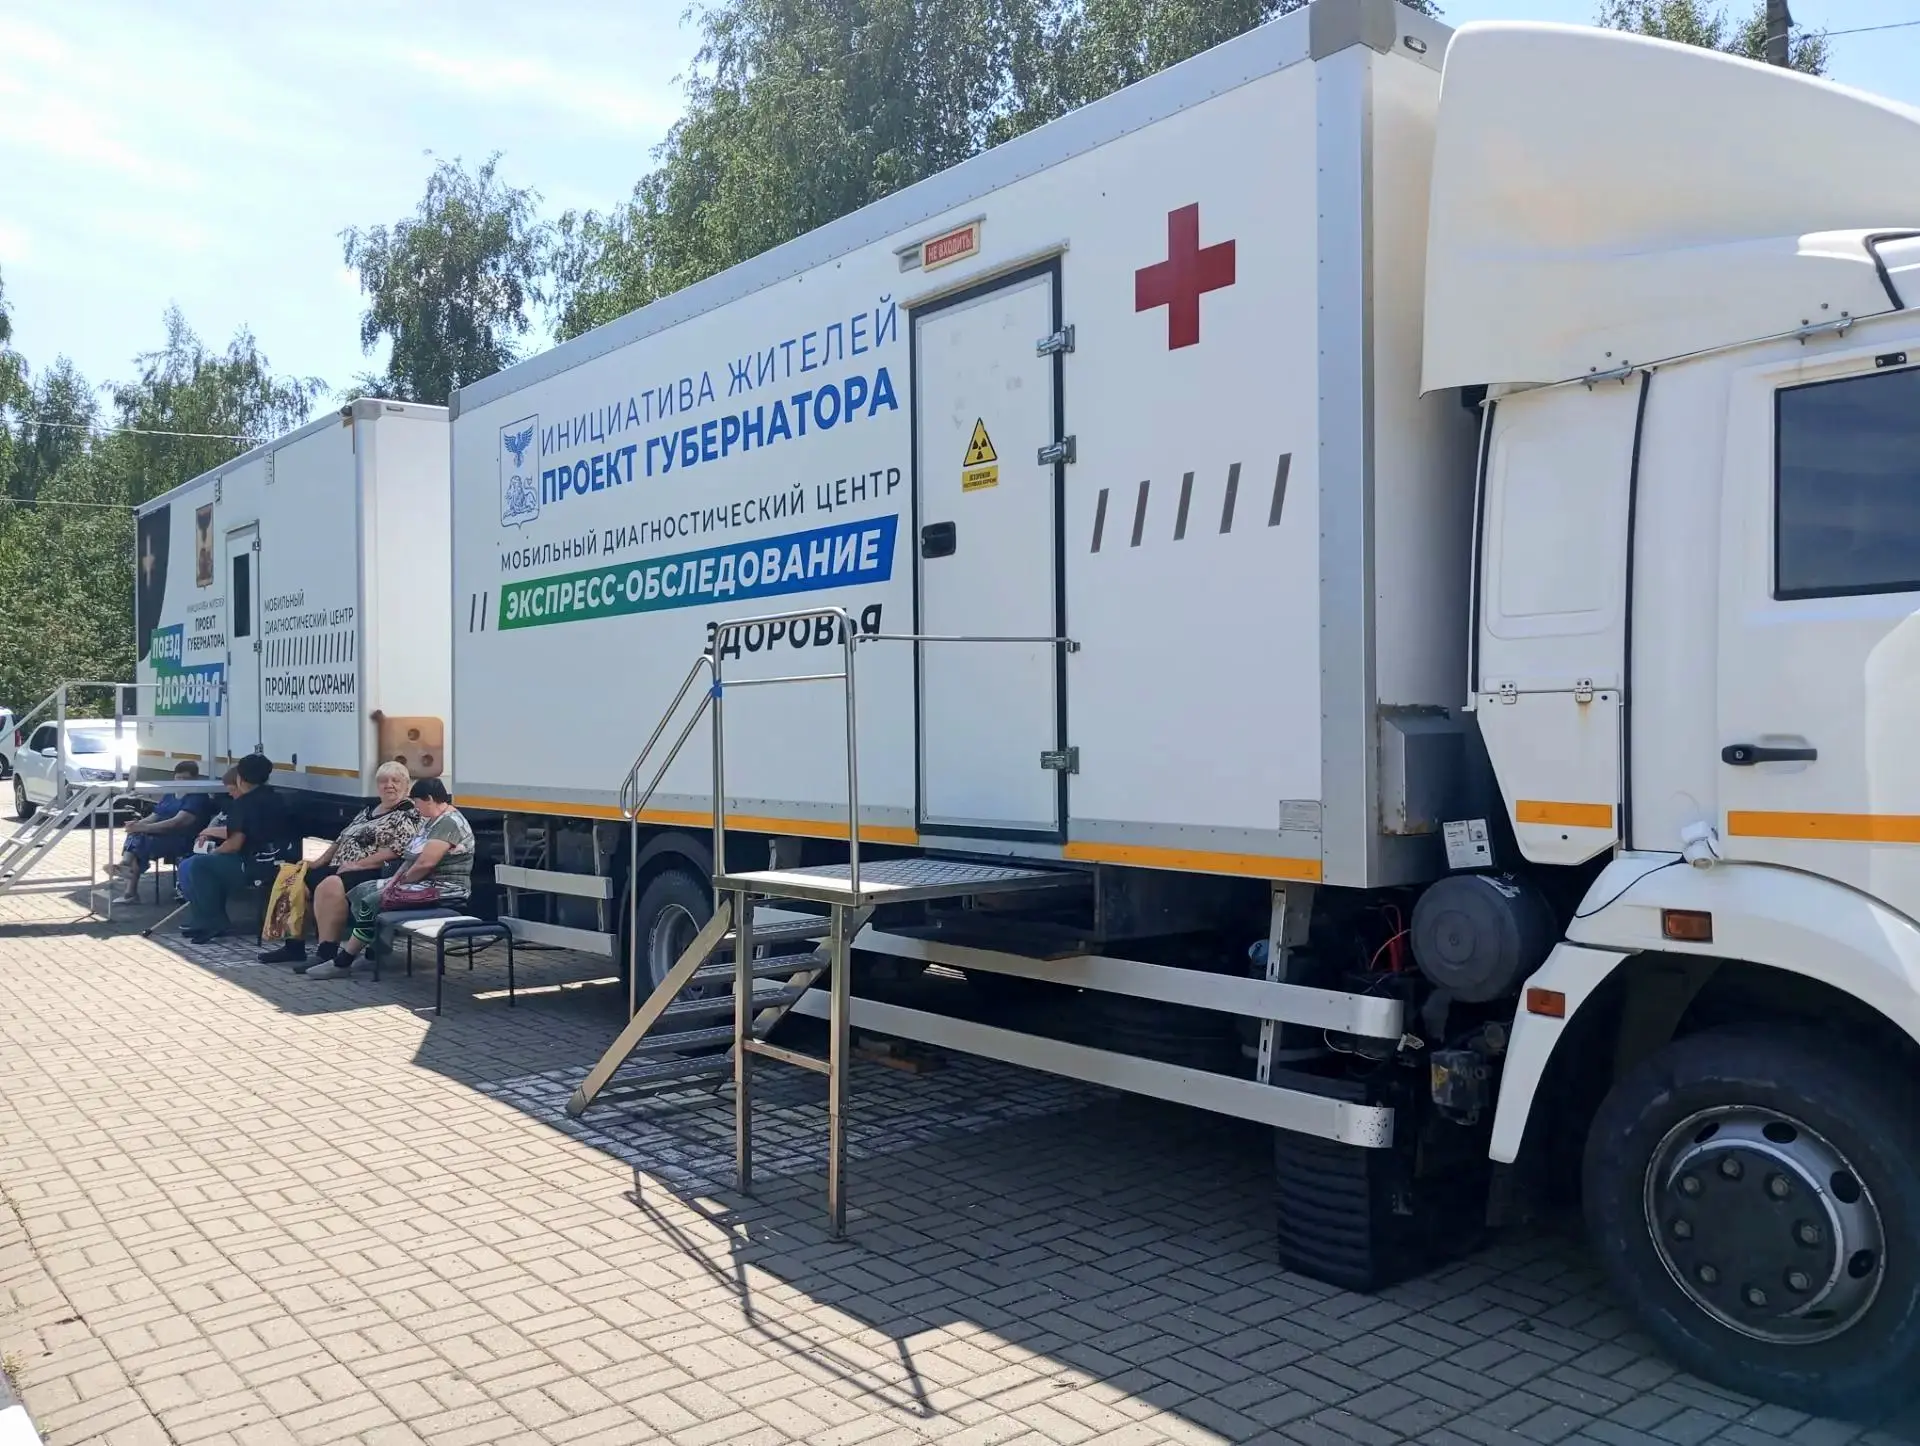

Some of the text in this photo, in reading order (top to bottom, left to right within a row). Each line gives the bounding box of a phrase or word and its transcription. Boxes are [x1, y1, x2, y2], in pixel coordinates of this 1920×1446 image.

[928, 234, 971, 262] НЕ ВХОДИТЬ
[542, 293, 897, 457] ИНИЦИАТИВА ЖИТЕЛЕЙ
[542, 367, 898, 505] ПРОЕКТ ГУБЕРНАТОРА
[501, 467, 901, 572] МОБИЛЬНЫЙ ДИАГНОСТИЧЕСКИЙ ЦЕНТР
[506, 529, 882, 620] ЭКСПРЕСС-ОБСЛЕДОВАНИЕ
[264, 588, 304, 612] МОБИЛЬНЫЙ
[195, 615, 216, 632] ПРОЕКТ
[264, 607, 354, 636] ДИАГНОСТИЧЕСКИЙ ЦЕНТР
[152, 633, 181, 660] ПОЕЗД
[187, 633, 225, 651] ГУБЕРНАТОРА
[157, 671, 220, 710] ЗДОРОВЬЯ
[265, 671, 355, 699] ПРОЙДИ СОХРАНИ
